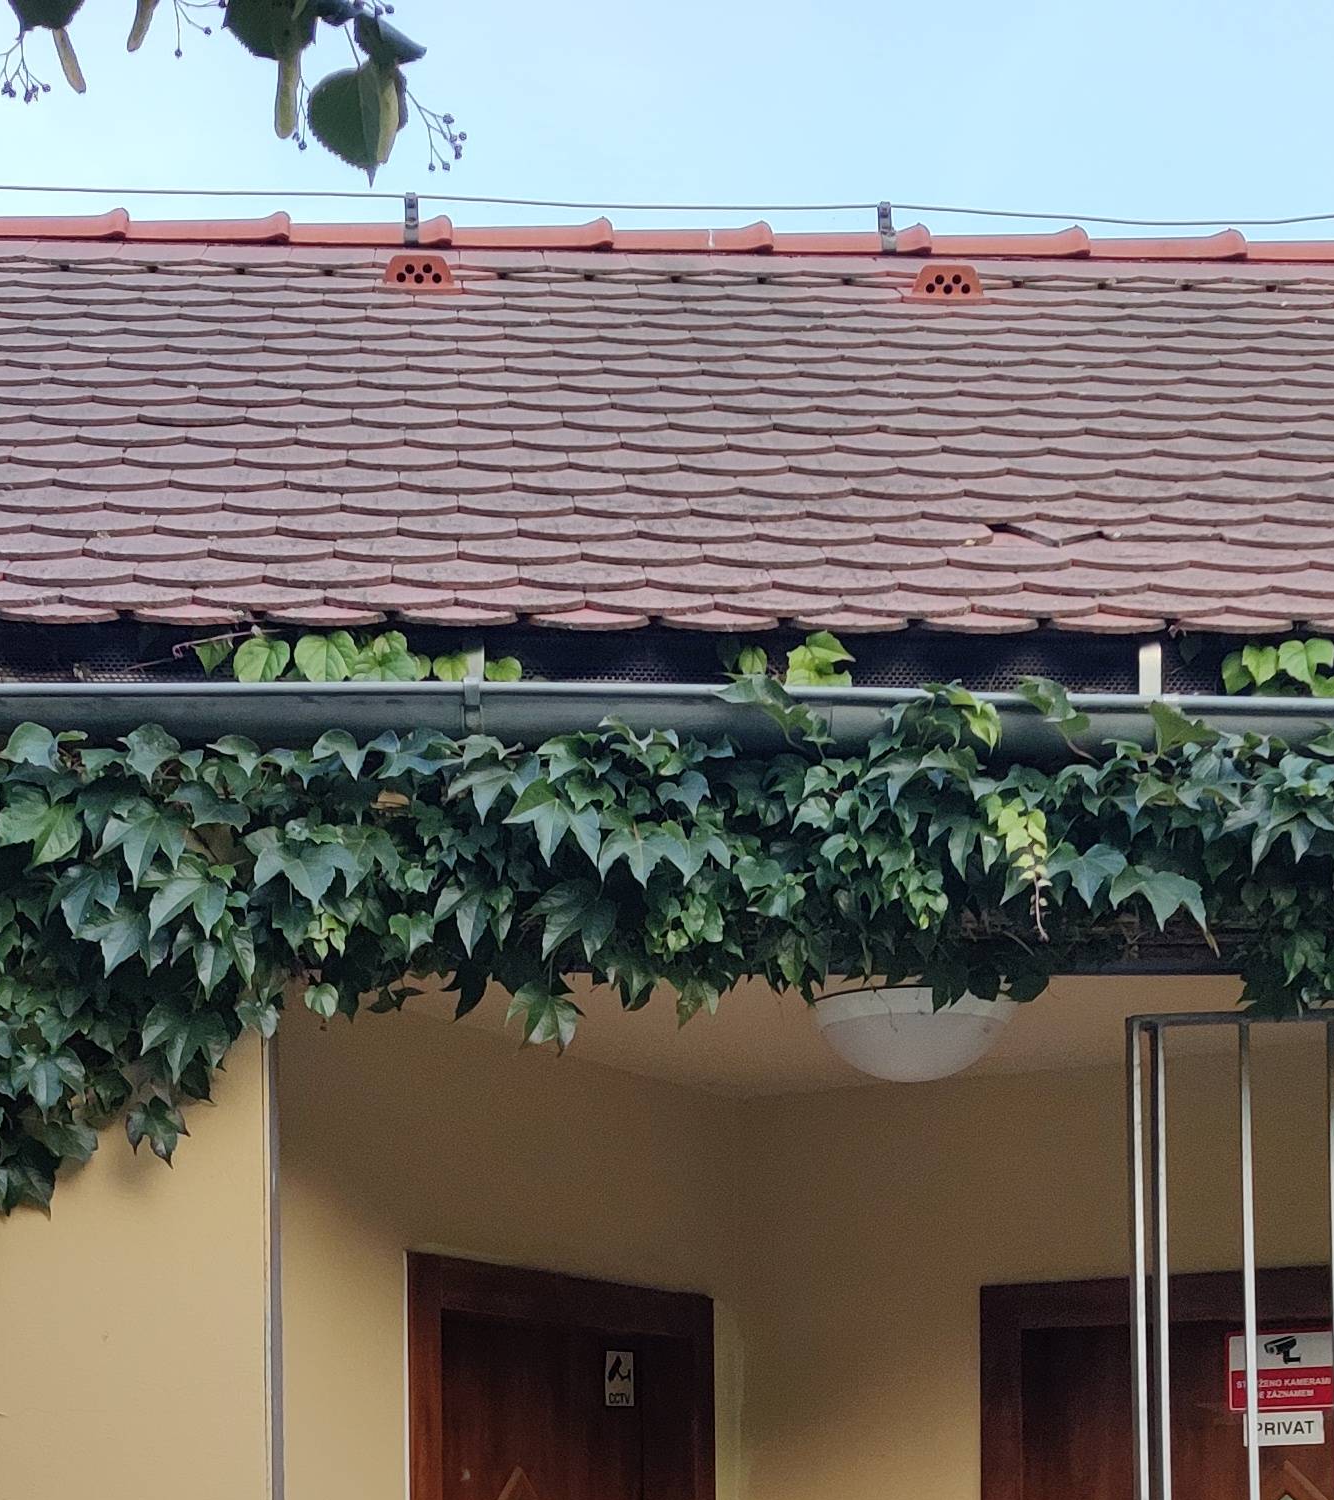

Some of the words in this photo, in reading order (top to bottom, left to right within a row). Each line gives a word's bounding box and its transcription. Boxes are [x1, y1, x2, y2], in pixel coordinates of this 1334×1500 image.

[1236, 1378, 1283, 1389] STŽENO
[1284, 1376, 1331, 1386] KAMERAMI
[609, 1392, 631, 1405] CCTV
[1266, 1389, 1314, 1399] ZÁZNAMEM
